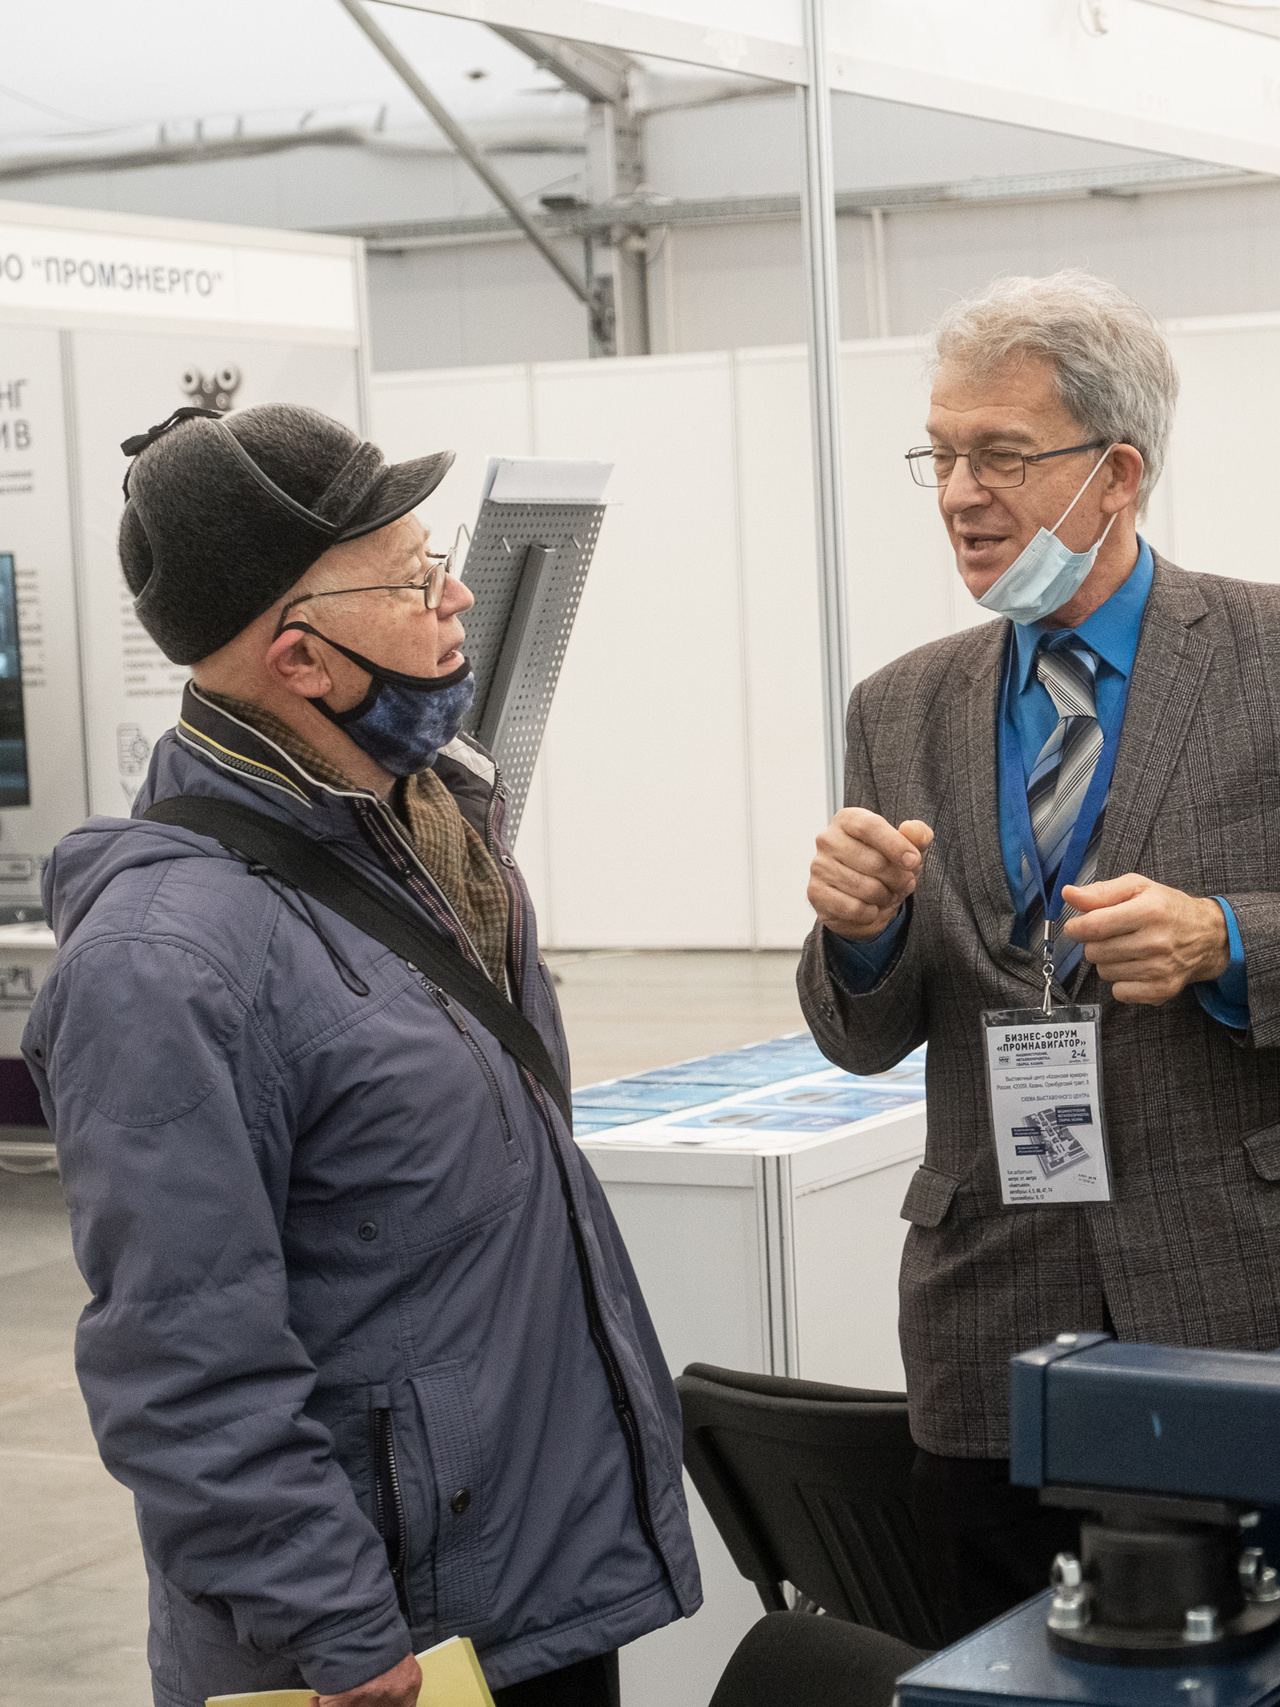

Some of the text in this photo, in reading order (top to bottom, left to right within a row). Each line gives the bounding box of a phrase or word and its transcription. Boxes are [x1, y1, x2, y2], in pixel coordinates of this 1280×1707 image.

[0, 253, 224, 297] О "ПРОМЭНЕРГО"
[1005, 1030, 1078, 1042] БИЗНЕС-ФОРУМ
[997, 1039, 1087, 1052] «ПРОМНАВИГАТОР»
[1071, 1049, 1087, 1059] 2-4
